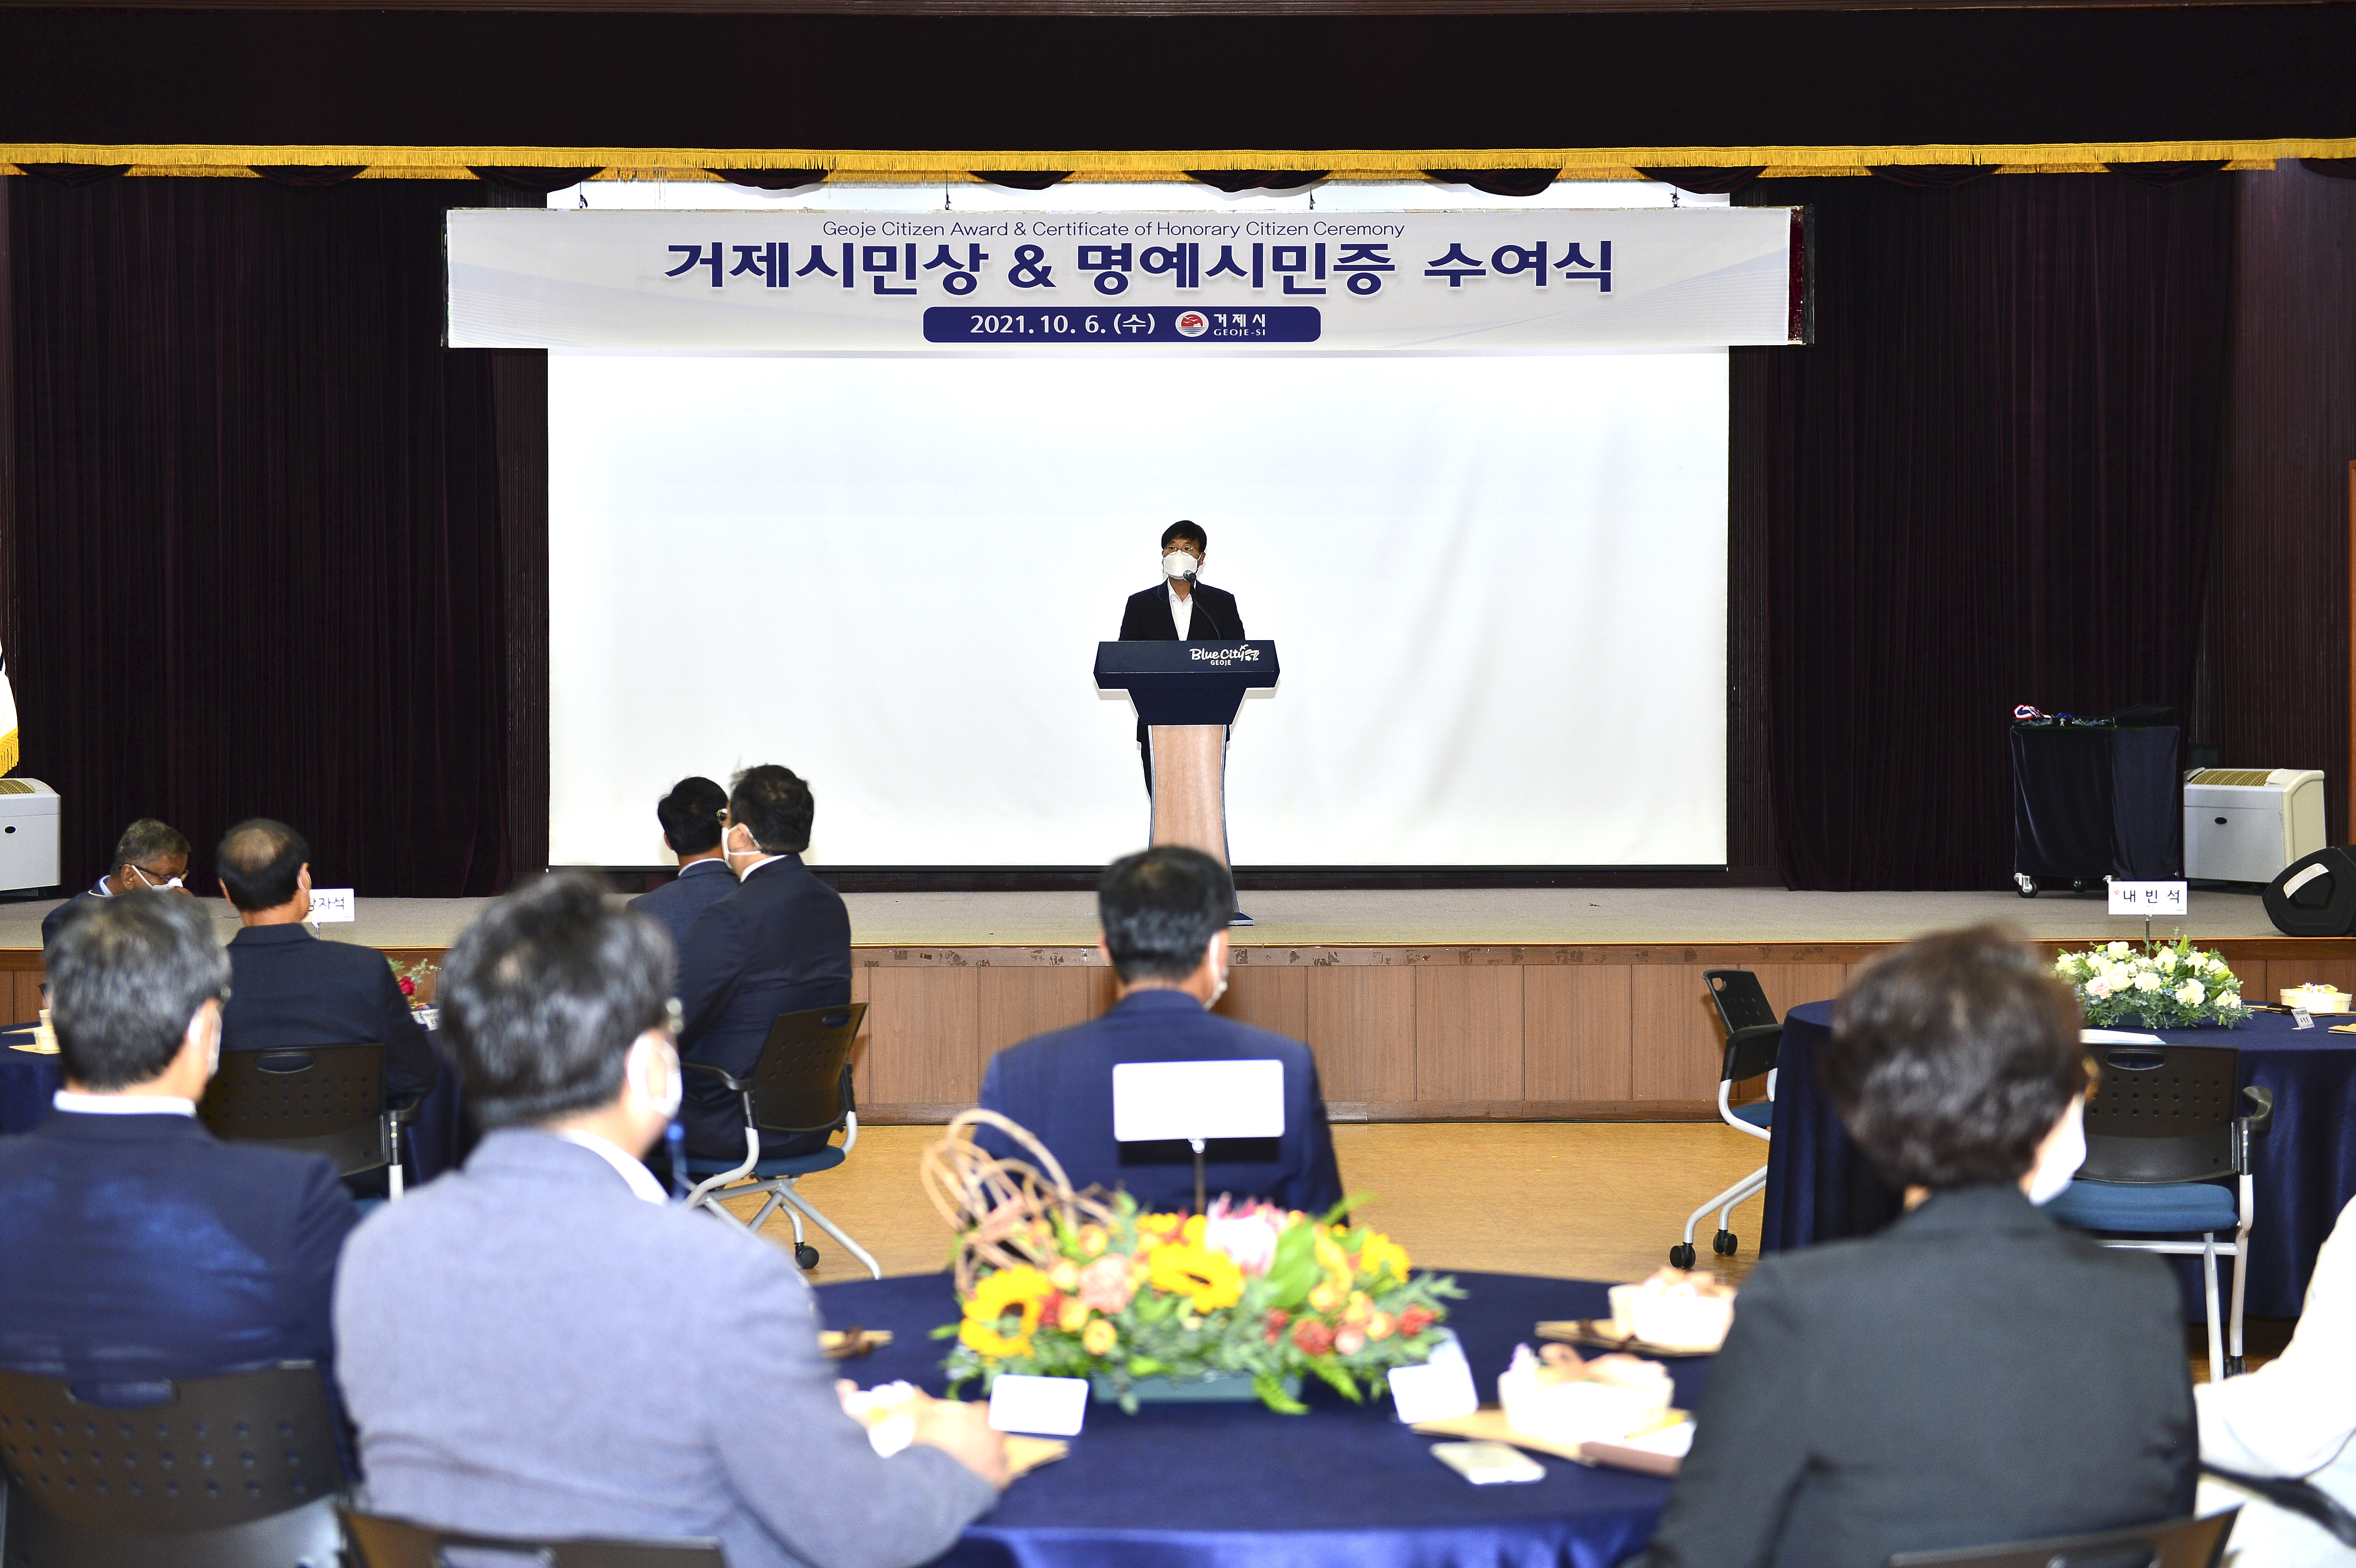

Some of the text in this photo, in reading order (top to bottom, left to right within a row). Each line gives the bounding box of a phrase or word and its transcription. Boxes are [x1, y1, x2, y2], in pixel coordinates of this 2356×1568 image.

[822, 221, 1405, 239] Geoje Citizen Award & Certificate of Honorary Citizen Ceremony
[664, 240, 1612, 296] 거제시민상 & 명예시민증 수여식
[1213, 329, 1265, 337] GEOJE-SI
[1189, 648, 1244, 662] Blue City
